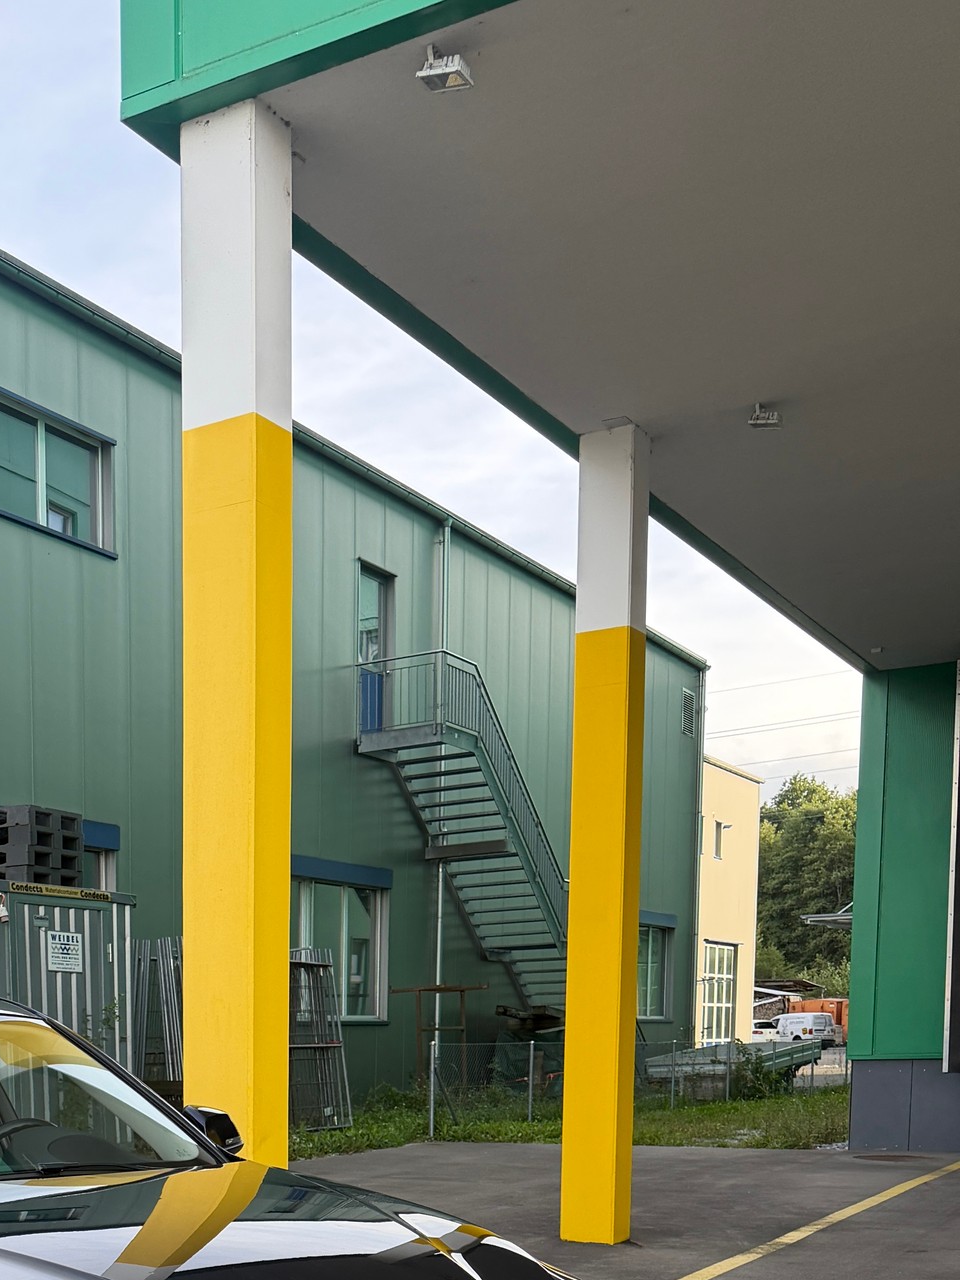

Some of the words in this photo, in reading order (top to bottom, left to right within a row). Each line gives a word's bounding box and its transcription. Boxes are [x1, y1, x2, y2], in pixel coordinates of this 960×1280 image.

[11, 882, 43, 893] Condecta
[80, 890, 110, 900] Condecta
[50, 933, 79, 943] WEIBEL
